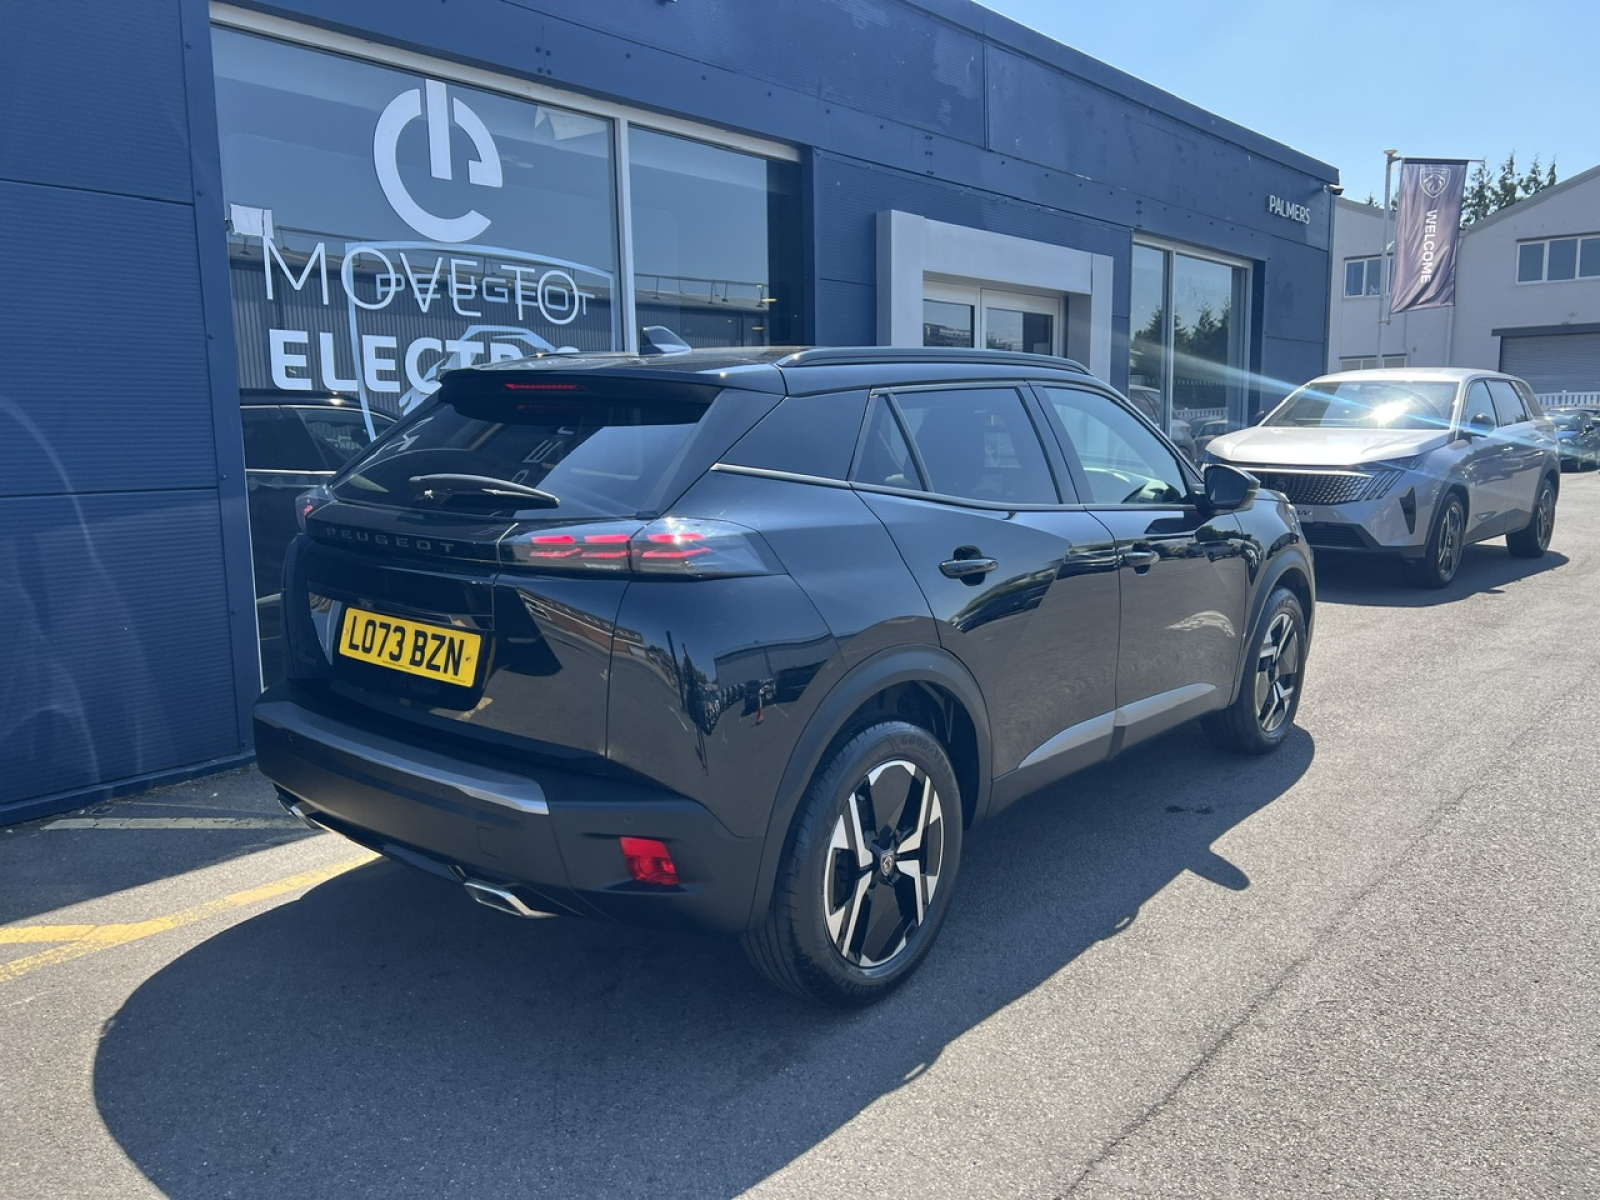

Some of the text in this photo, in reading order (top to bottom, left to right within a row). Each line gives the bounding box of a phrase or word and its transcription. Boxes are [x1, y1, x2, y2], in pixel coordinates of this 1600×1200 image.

[1269, 194, 1310, 225] PALMERS
[1420, 209, 1438, 284] WELCOME
[262, 236, 580, 325] MOVE TO
[375, 273, 597, 316] PEUGEOT
[269, 328, 580, 395] ELECT
[325, 527, 455, 554] PEUGEOT
[409, 629, 465, 677] BZN
